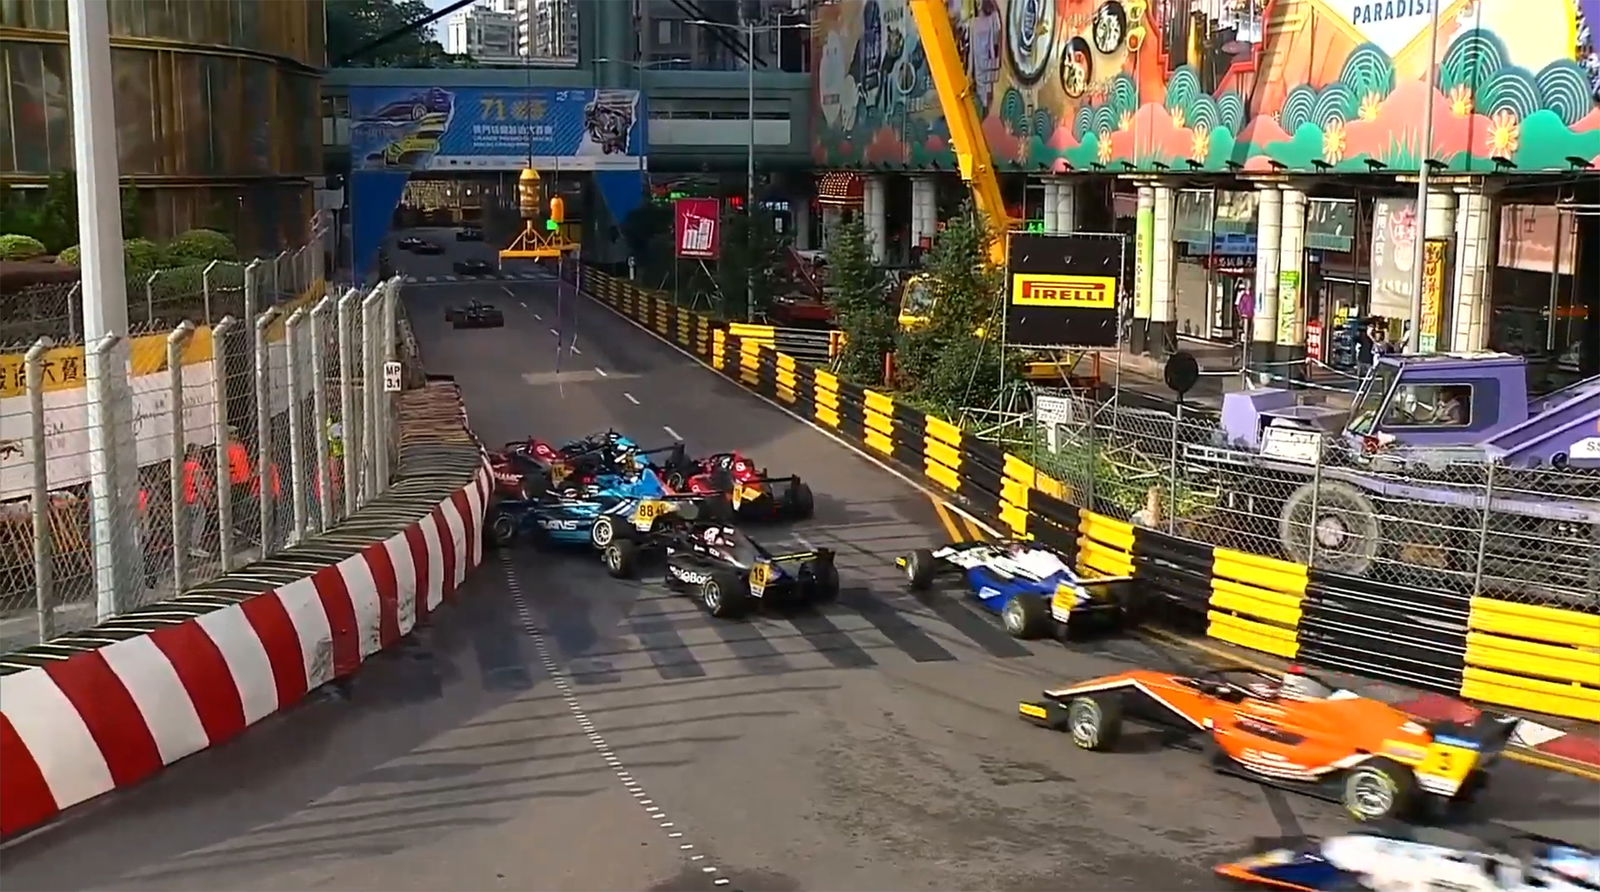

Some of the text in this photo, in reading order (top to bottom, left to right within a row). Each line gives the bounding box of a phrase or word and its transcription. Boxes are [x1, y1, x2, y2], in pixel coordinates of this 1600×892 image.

[1353, 0, 1431, 25] PARADIS
[1022, 280, 1106, 302] PIRELLI
[386, 365, 400, 375] MP
[386, 378, 400, 388] 3.1
[640, 504, 654, 517] 88
[753, 566, 765, 581] 19
